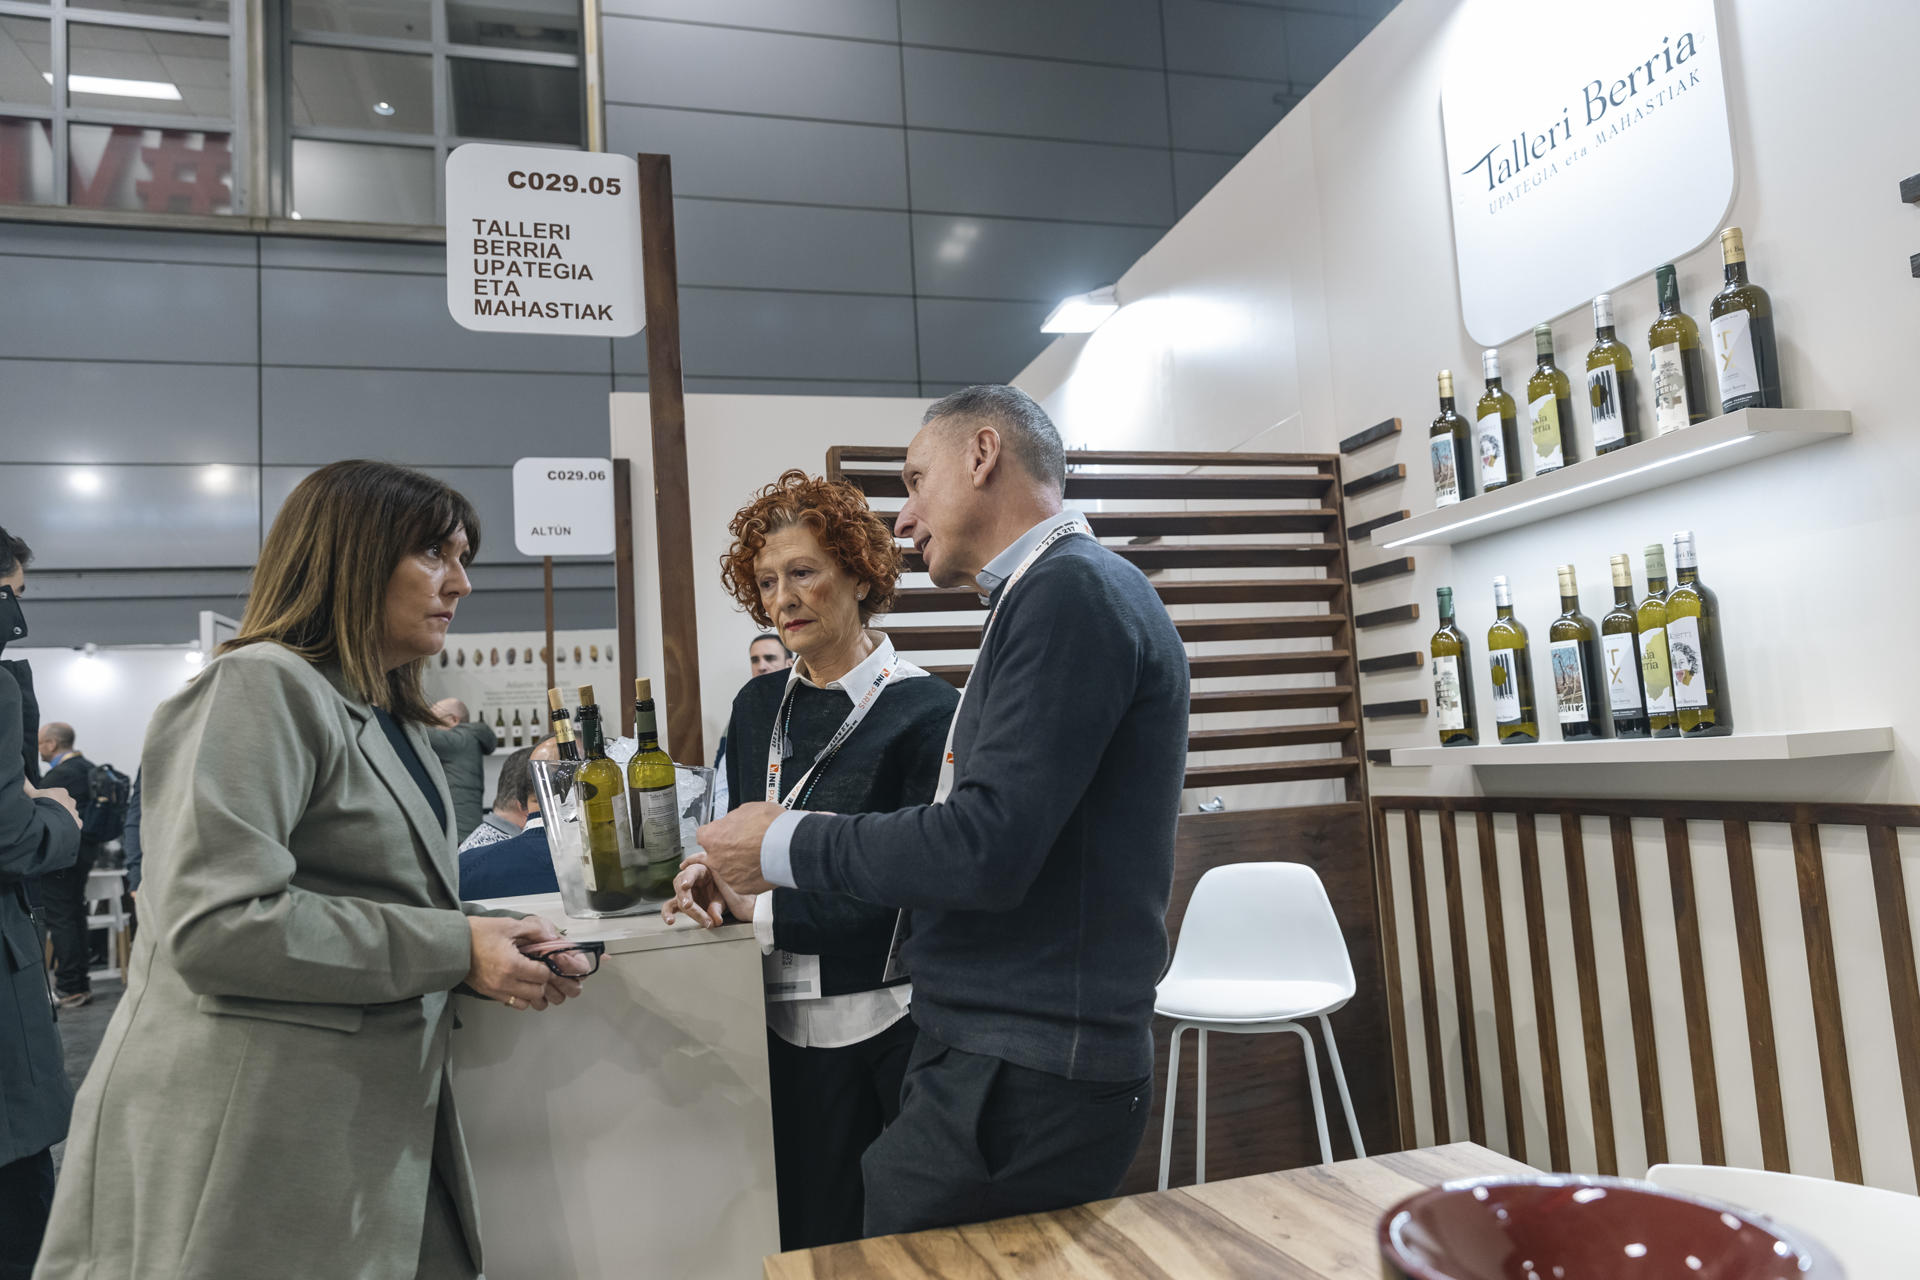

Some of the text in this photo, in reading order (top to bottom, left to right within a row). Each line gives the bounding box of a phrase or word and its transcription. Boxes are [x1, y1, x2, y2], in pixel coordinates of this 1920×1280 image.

[1462, 31, 1698, 192] Talleri Berria
[1488, 68, 1703, 215] UPATEGIA eta MAHASTIAK
[507, 170, 622, 196] C029.05
[473, 218, 570, 240] TALLERI
[473, 239, 563, 260] BERRIA
[473, 259, 593, 281] UPATEGIA
[473, 279, 520, 297] ETA
[473, 299, 614, 321] MAHASTIAK
[547, 470, 606, 481] C029.06
